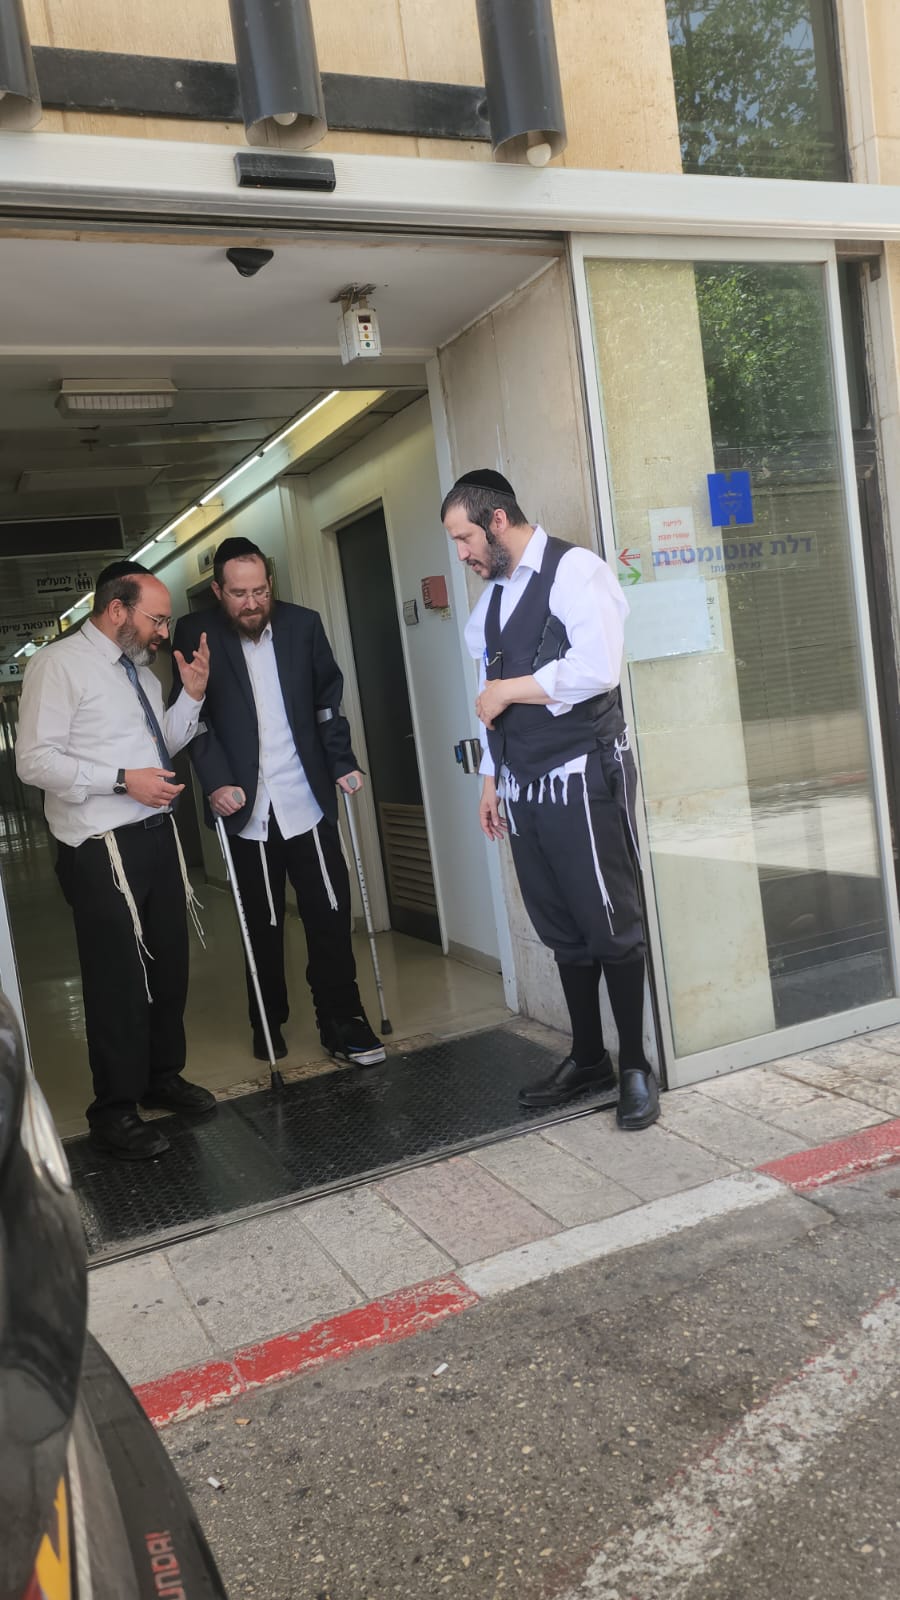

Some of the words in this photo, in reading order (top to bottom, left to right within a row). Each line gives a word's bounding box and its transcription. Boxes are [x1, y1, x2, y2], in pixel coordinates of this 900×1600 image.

[770, 534, 812, 555] דלת
[652, 541, 763, 567] אוטומטית
[37, 576, 72, 587] למעליות
[23, 619, 55, 631] מרפאת
